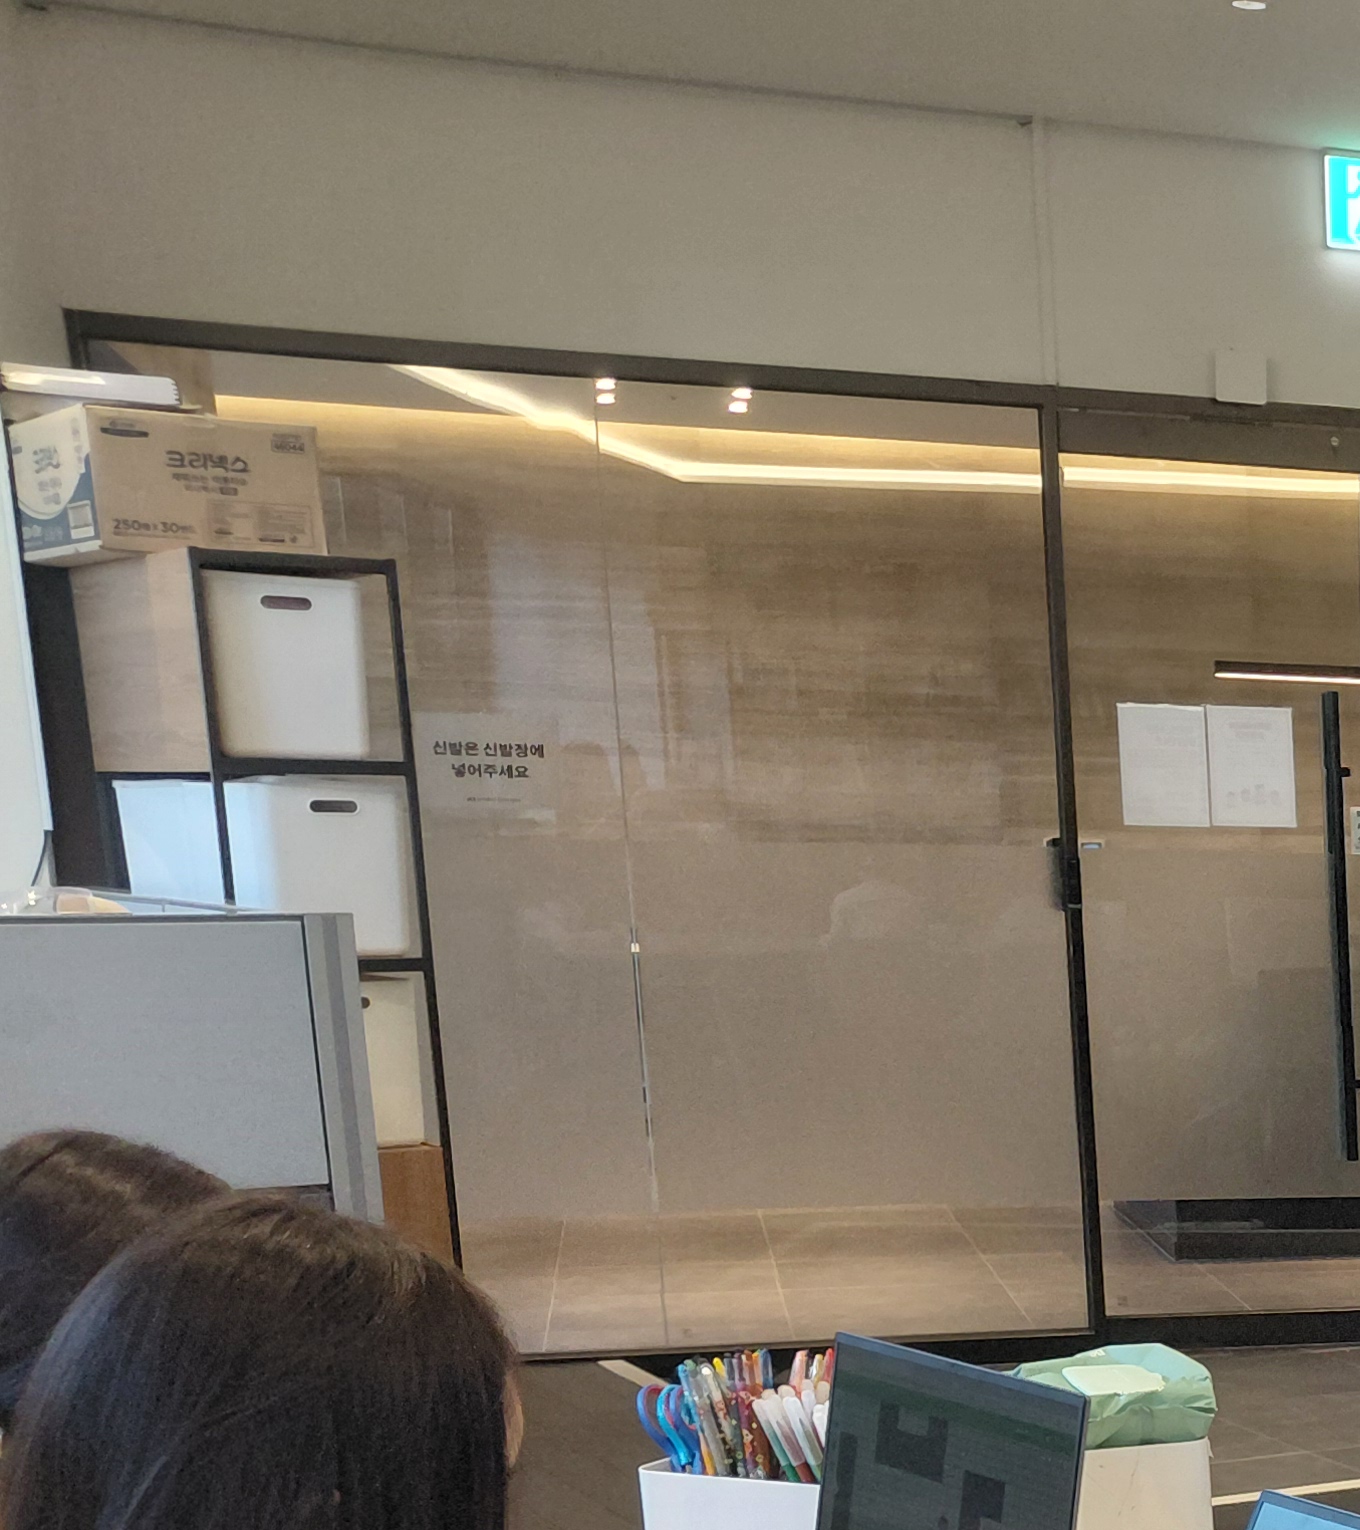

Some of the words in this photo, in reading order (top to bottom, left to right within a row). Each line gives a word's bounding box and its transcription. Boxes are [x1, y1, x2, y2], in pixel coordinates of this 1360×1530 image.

[165, 450, 250, 474] 크리넥스
[433, 740, 479, 756] 신발은
[484, 742, 545, 758] 신발장에
[451, 763, 529, 779] 넣어주세요
